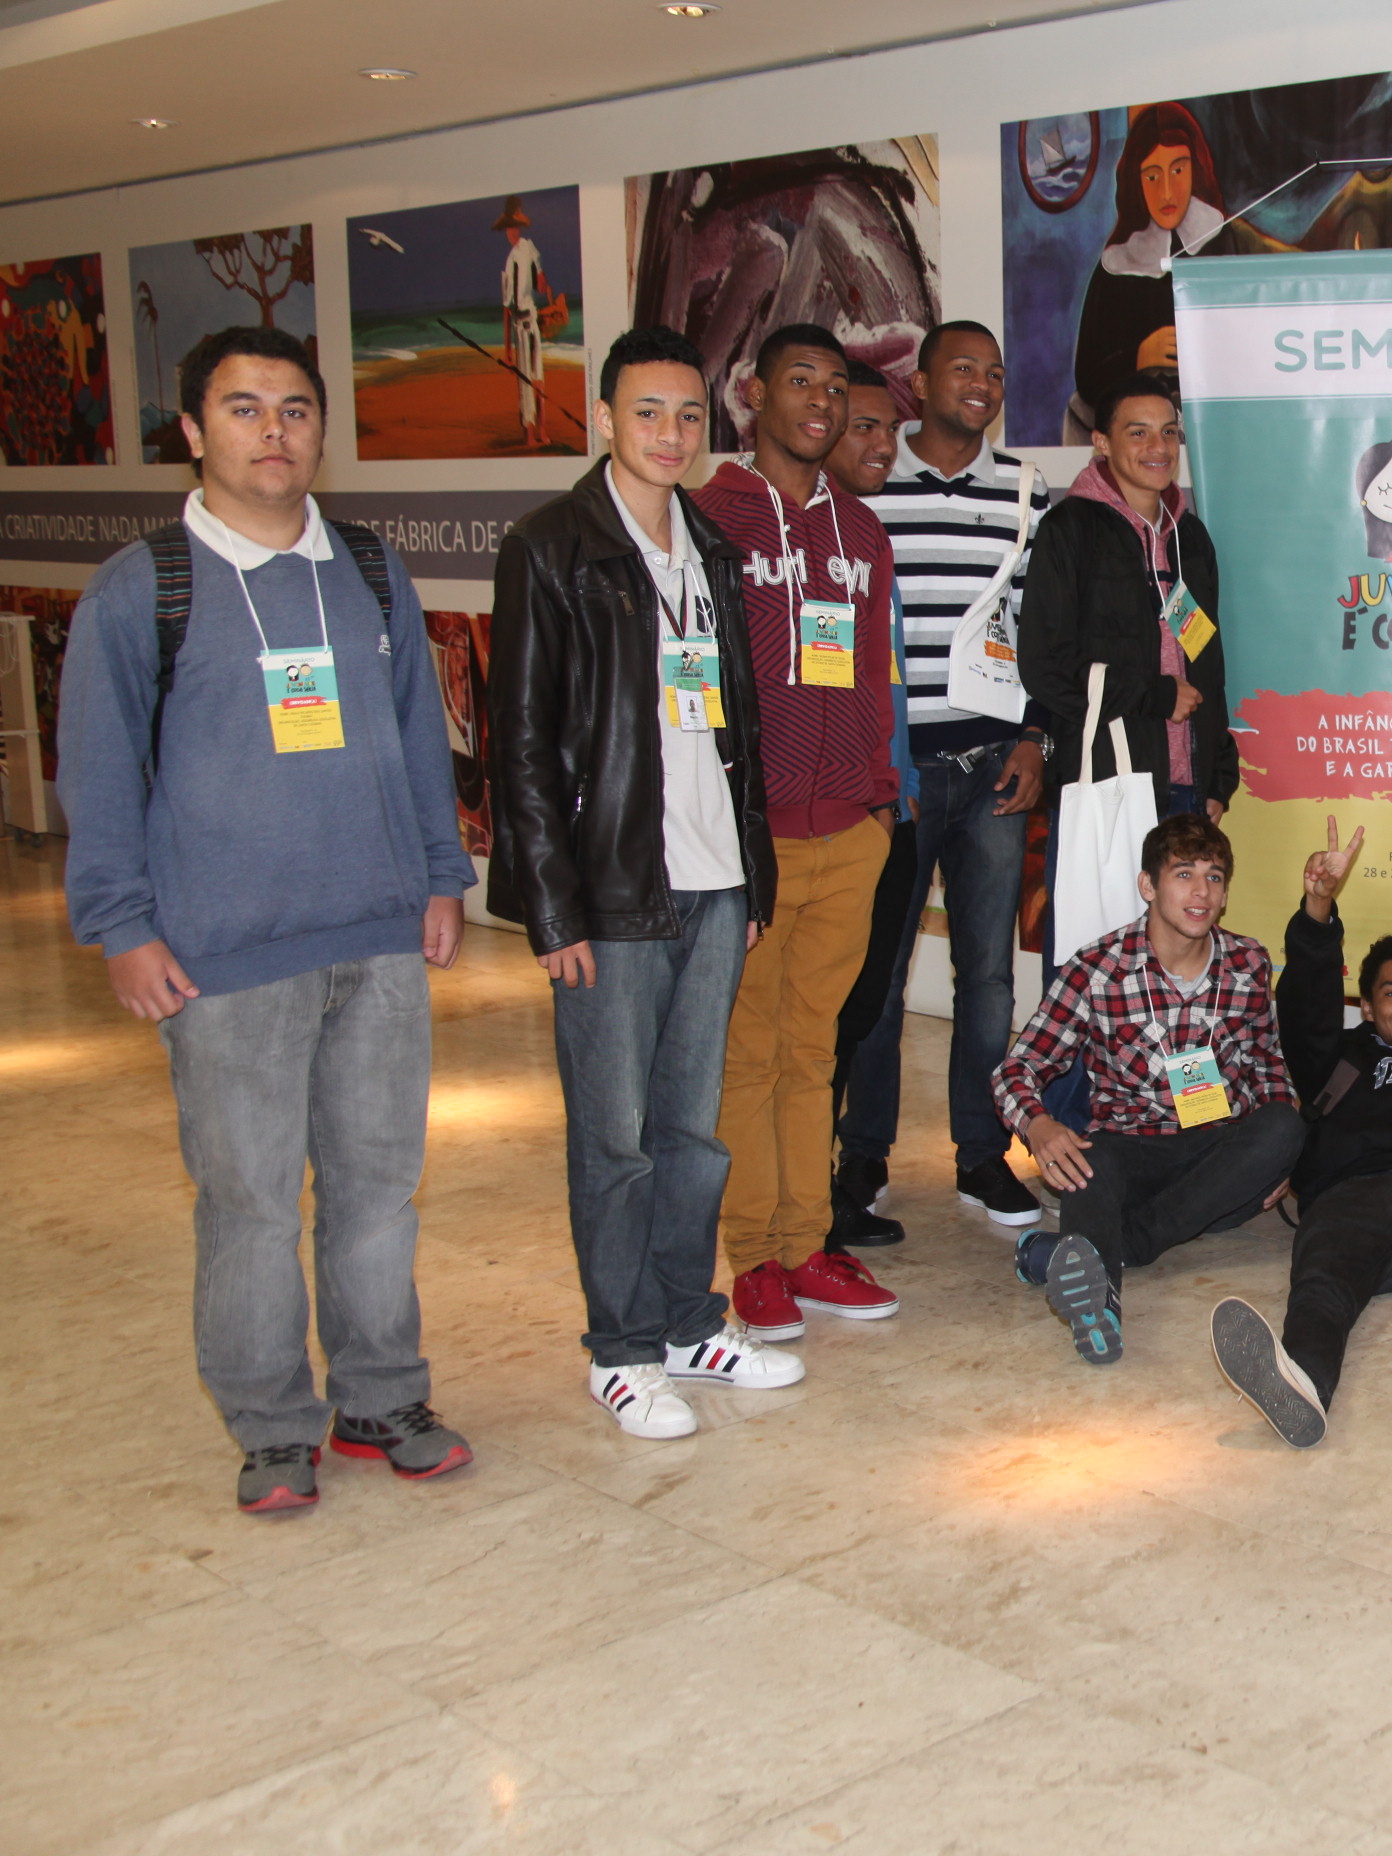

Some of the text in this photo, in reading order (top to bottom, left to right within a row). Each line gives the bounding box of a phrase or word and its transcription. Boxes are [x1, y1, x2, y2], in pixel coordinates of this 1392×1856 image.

[4, 515, 96, 542] CRIATIVIDADE
[100, 516, 141, 543] NADA
[386, 514, 467, 553] FÁBRICA
[471, 520, 500, 553] DE
[1342, 606, 1368, 650] É
[1318, 715, 1329, 730] A
[1297, 736, 1317, 752] DO
[1323, 737, 1384, 755] BRASIL
[1325, 761, 1337, 776] E
[1343, 762, 1354, 777] A
[1363, 867, 1377, 878] 28
[1380, 870, 1387, 878] e
